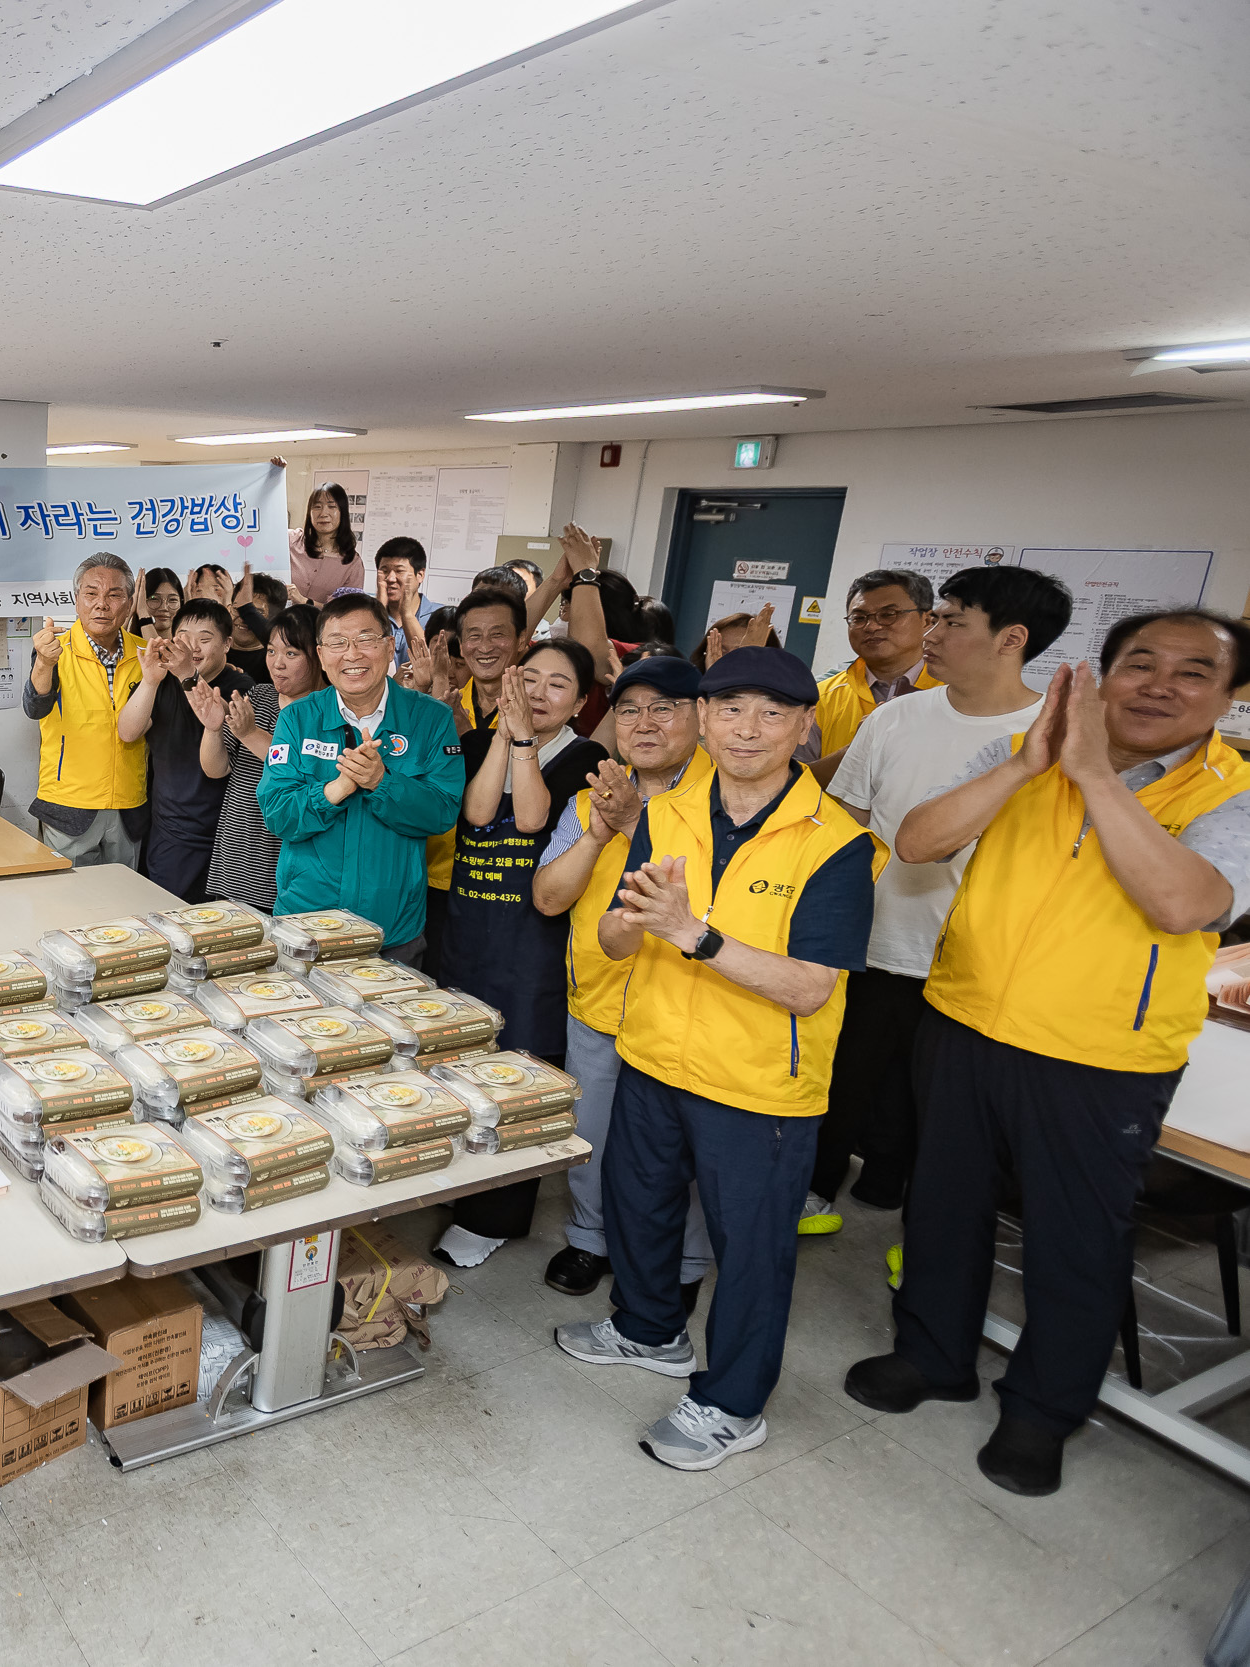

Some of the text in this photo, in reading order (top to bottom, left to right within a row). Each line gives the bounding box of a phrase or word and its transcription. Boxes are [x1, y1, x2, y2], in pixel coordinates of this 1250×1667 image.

[18, 500, 118, 539] 자라는
[943, 547, 983, 559] 안전수칙
[11, 590, 76, 607] 지역사회
[495, 857, 513, 868] 있을
[515, 857, 534, 868] 때가
[468, 869, 503, 882] 제일 예뻐
[468, 890, 522, 903] 02-468-4376
